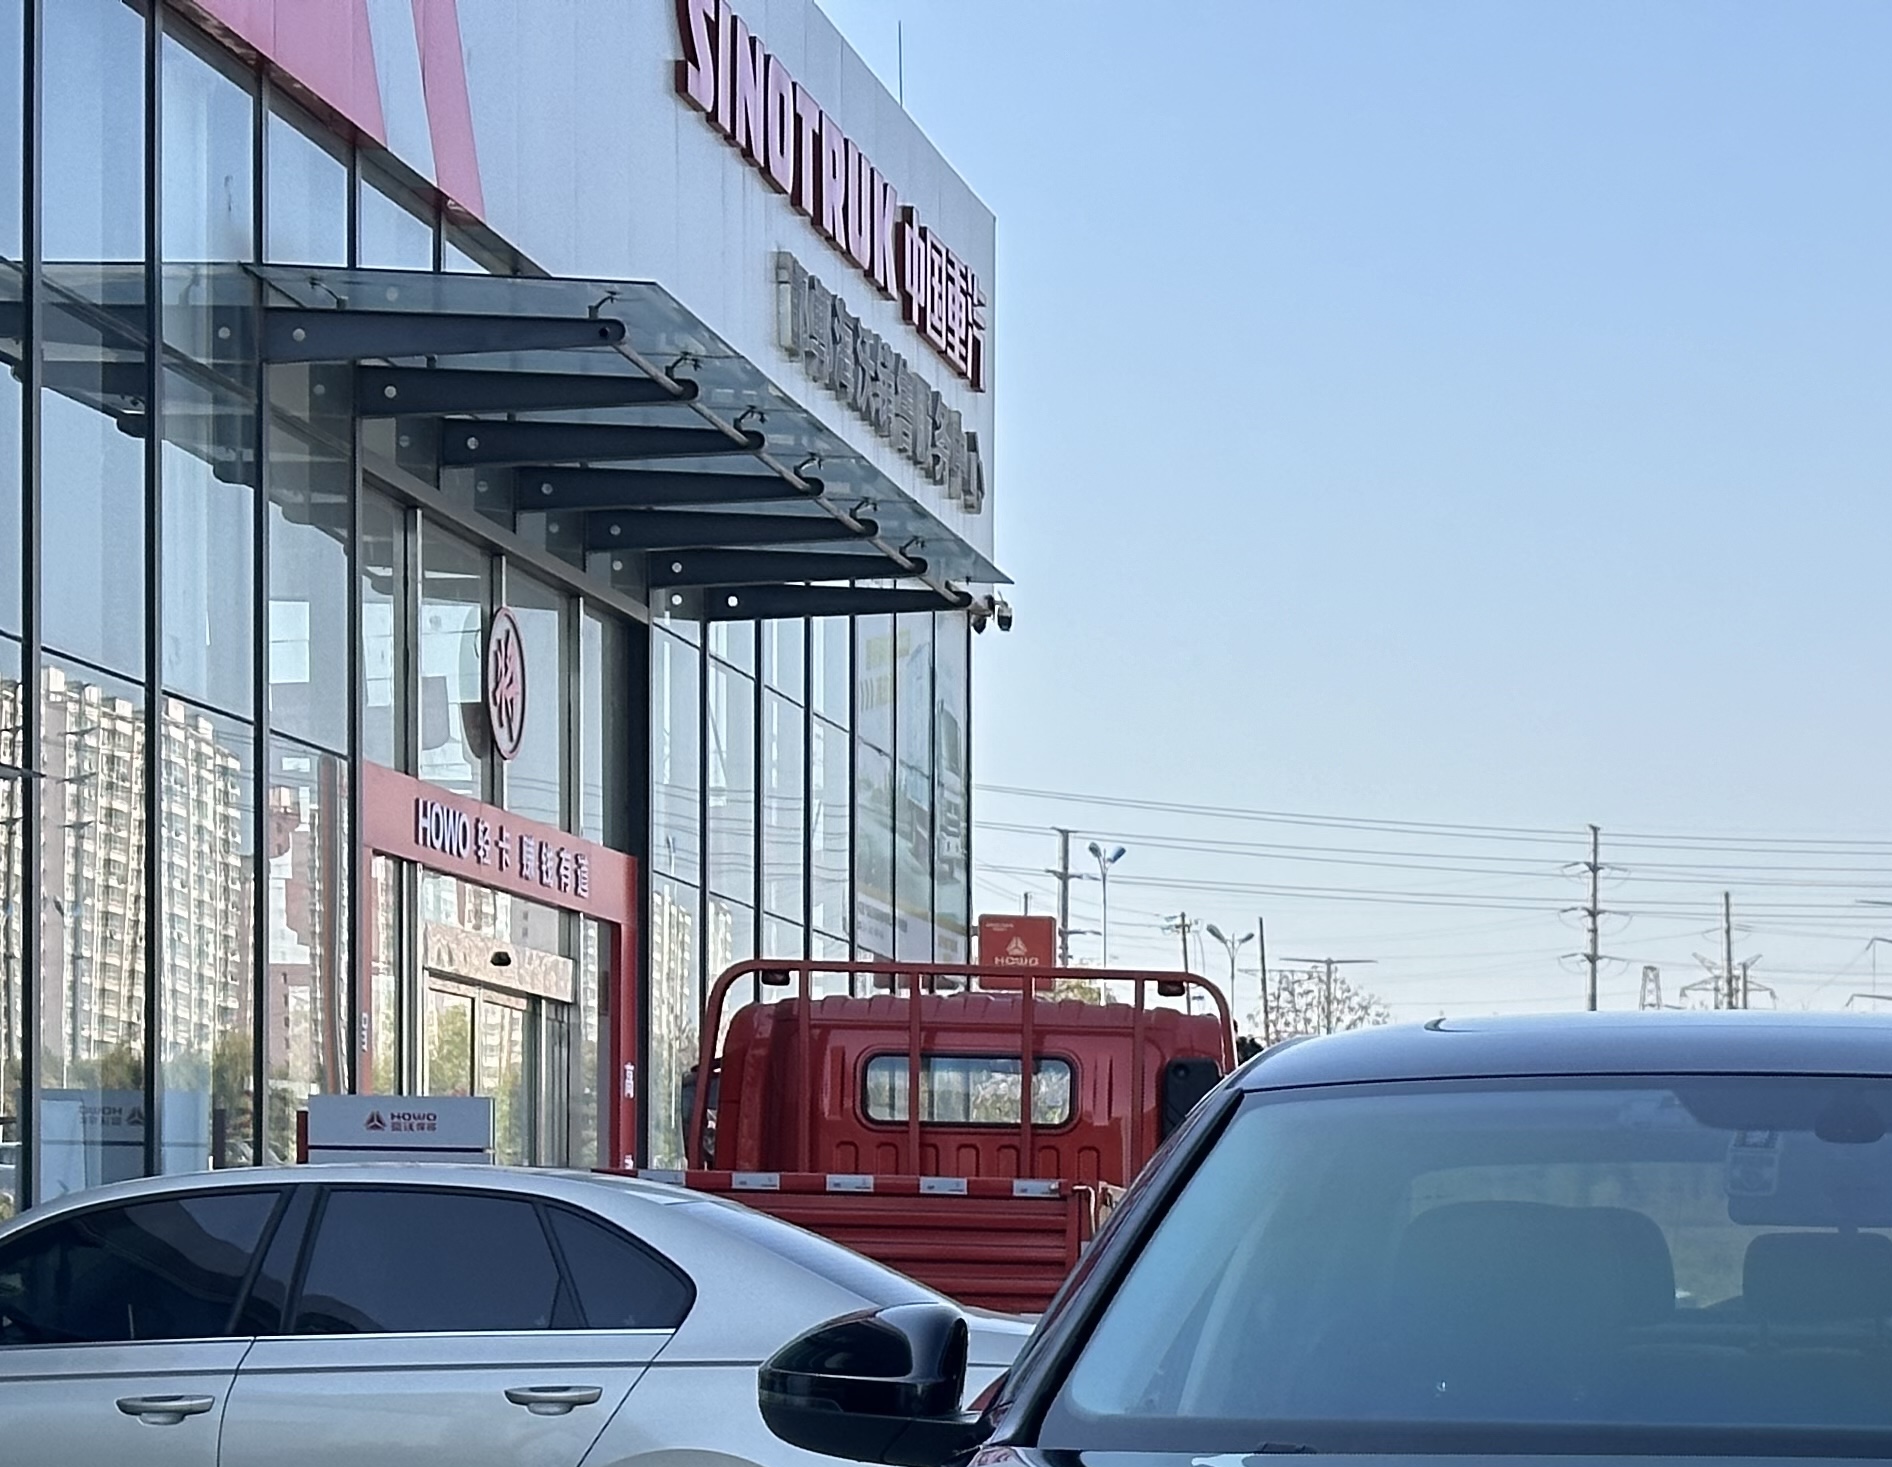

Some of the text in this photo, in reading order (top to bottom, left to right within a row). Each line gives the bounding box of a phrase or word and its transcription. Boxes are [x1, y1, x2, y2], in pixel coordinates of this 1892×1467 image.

[675, 0, 897, 300] SINOTRUK
[415, 797, 469, 857] HOWO
[390, 1112, 437, 1121] HOWO
